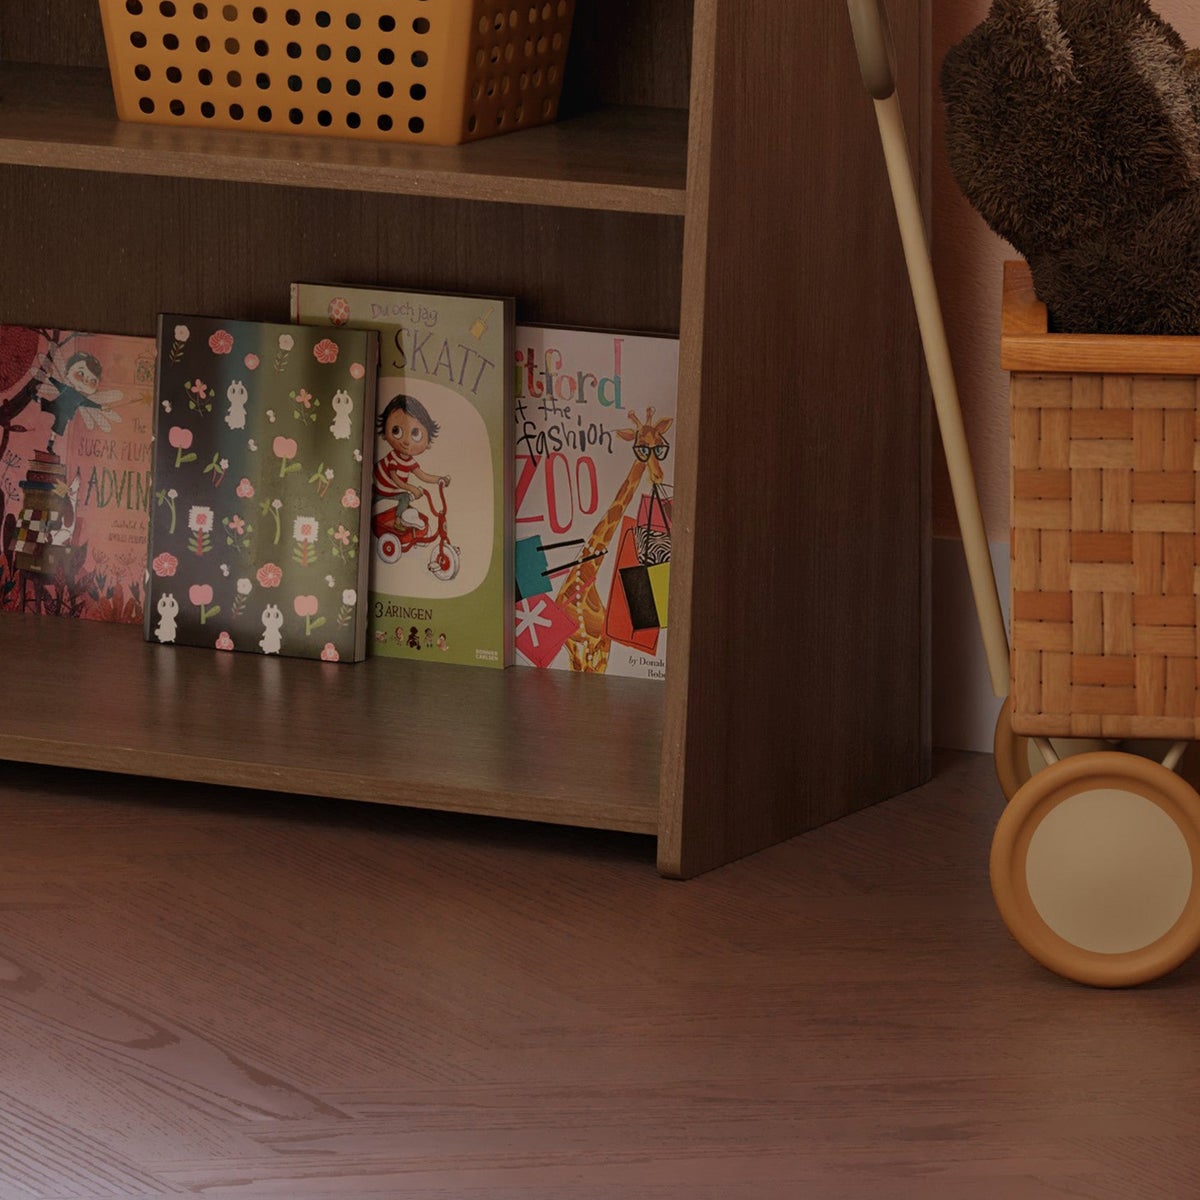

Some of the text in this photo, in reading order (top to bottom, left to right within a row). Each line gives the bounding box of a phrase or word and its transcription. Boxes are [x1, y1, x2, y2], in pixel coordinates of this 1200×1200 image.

[392, 302, 414, 316] och
[411, 305, 438, 327] jag
[392, 327, 496, 396] SKATT
[538, 398, 572, 421] the
[78, 437, 120, 461] SUGAR
[517, 414, 614, 468] fashion
[514, 451, 599, 534] ZOO
[628, 656, 638, 667] by
